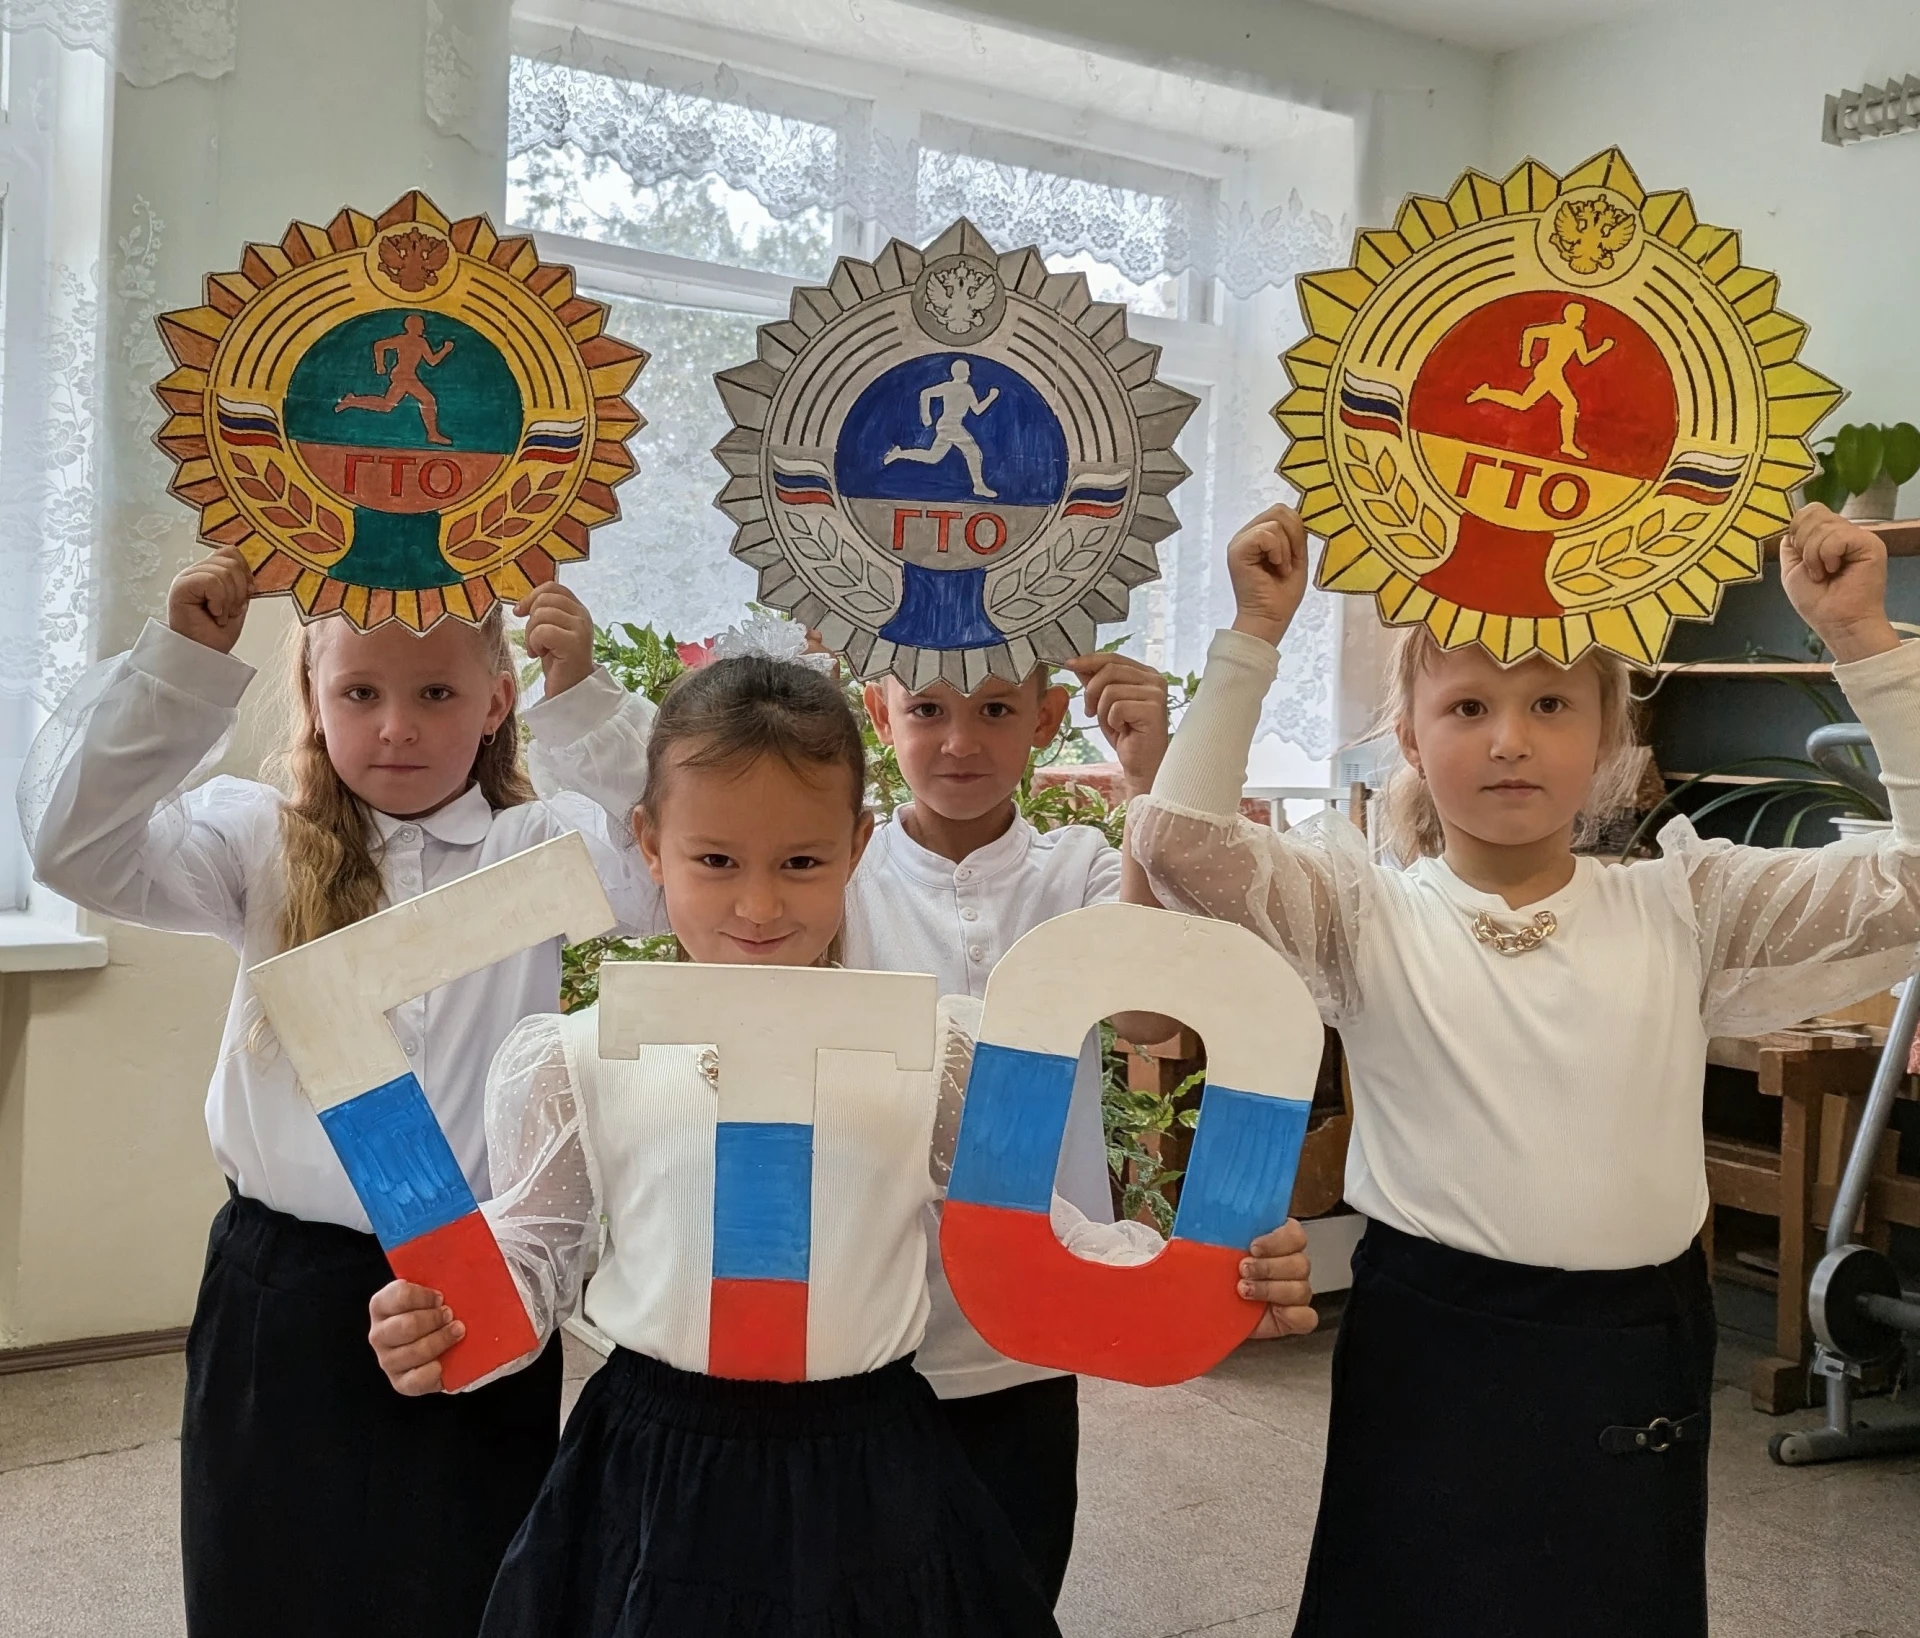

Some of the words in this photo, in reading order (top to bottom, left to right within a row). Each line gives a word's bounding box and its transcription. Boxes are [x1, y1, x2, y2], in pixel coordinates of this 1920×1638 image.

[343, 454, 462, 499] ГТО
[1455, 452, 1590, 520] ГТО
[893, 508, 1007, 555] ГТО
[250, 832, 1324, 1392] ГТО
